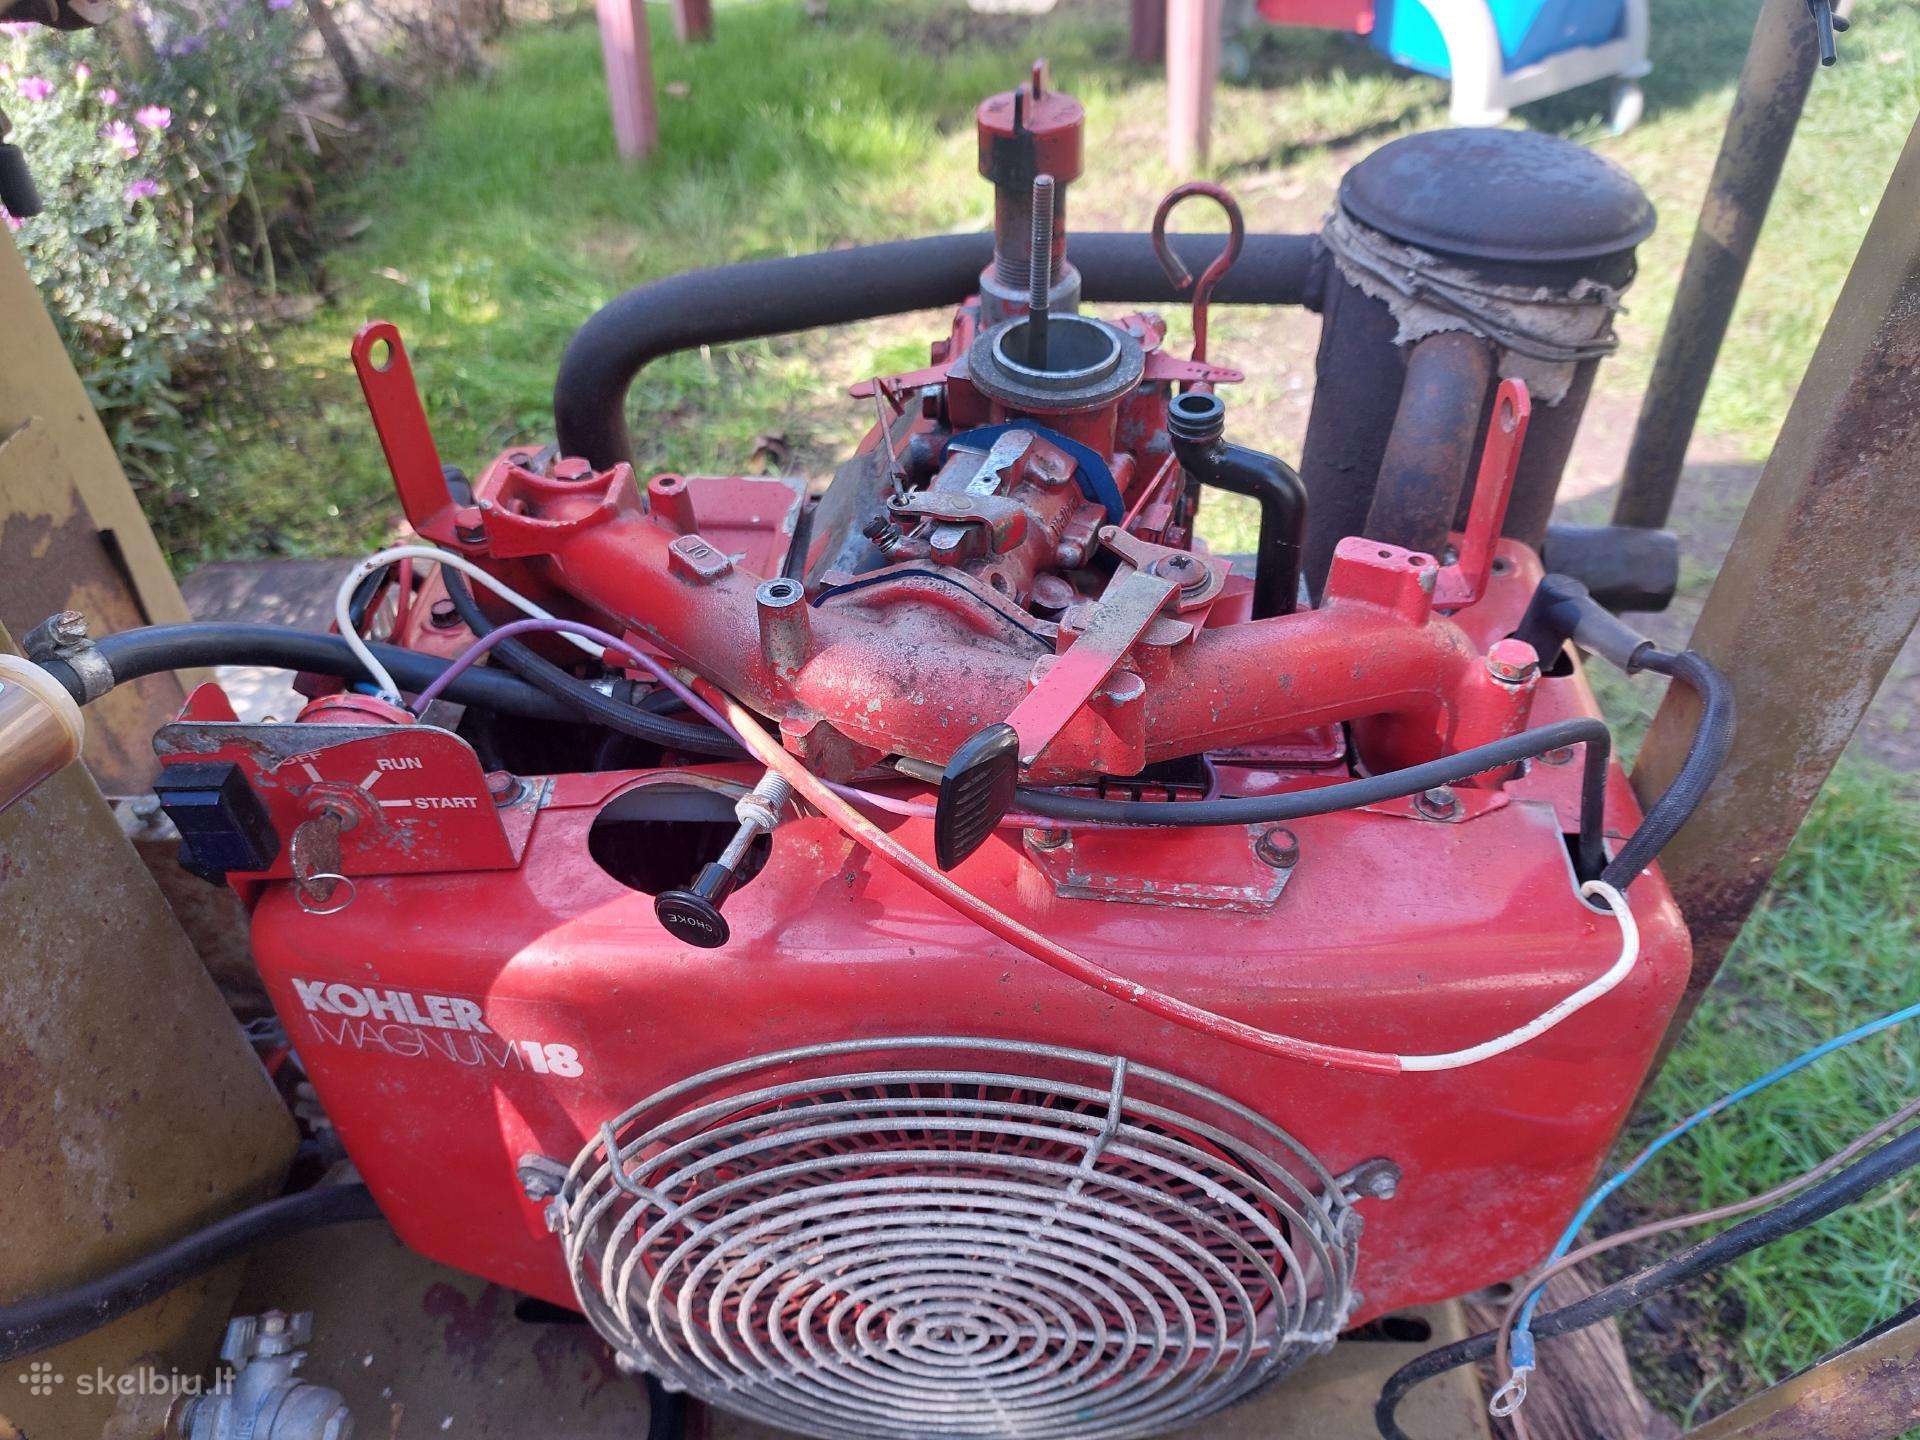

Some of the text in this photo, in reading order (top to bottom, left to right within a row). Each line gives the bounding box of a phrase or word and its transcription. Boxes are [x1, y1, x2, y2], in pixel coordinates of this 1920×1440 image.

[377, 757, 423, 770] RUN
[414, 797, 477, 809] START
[667, 913, 713, 932] CHOKE
[292, 978, 493, 1034] KOHLER
